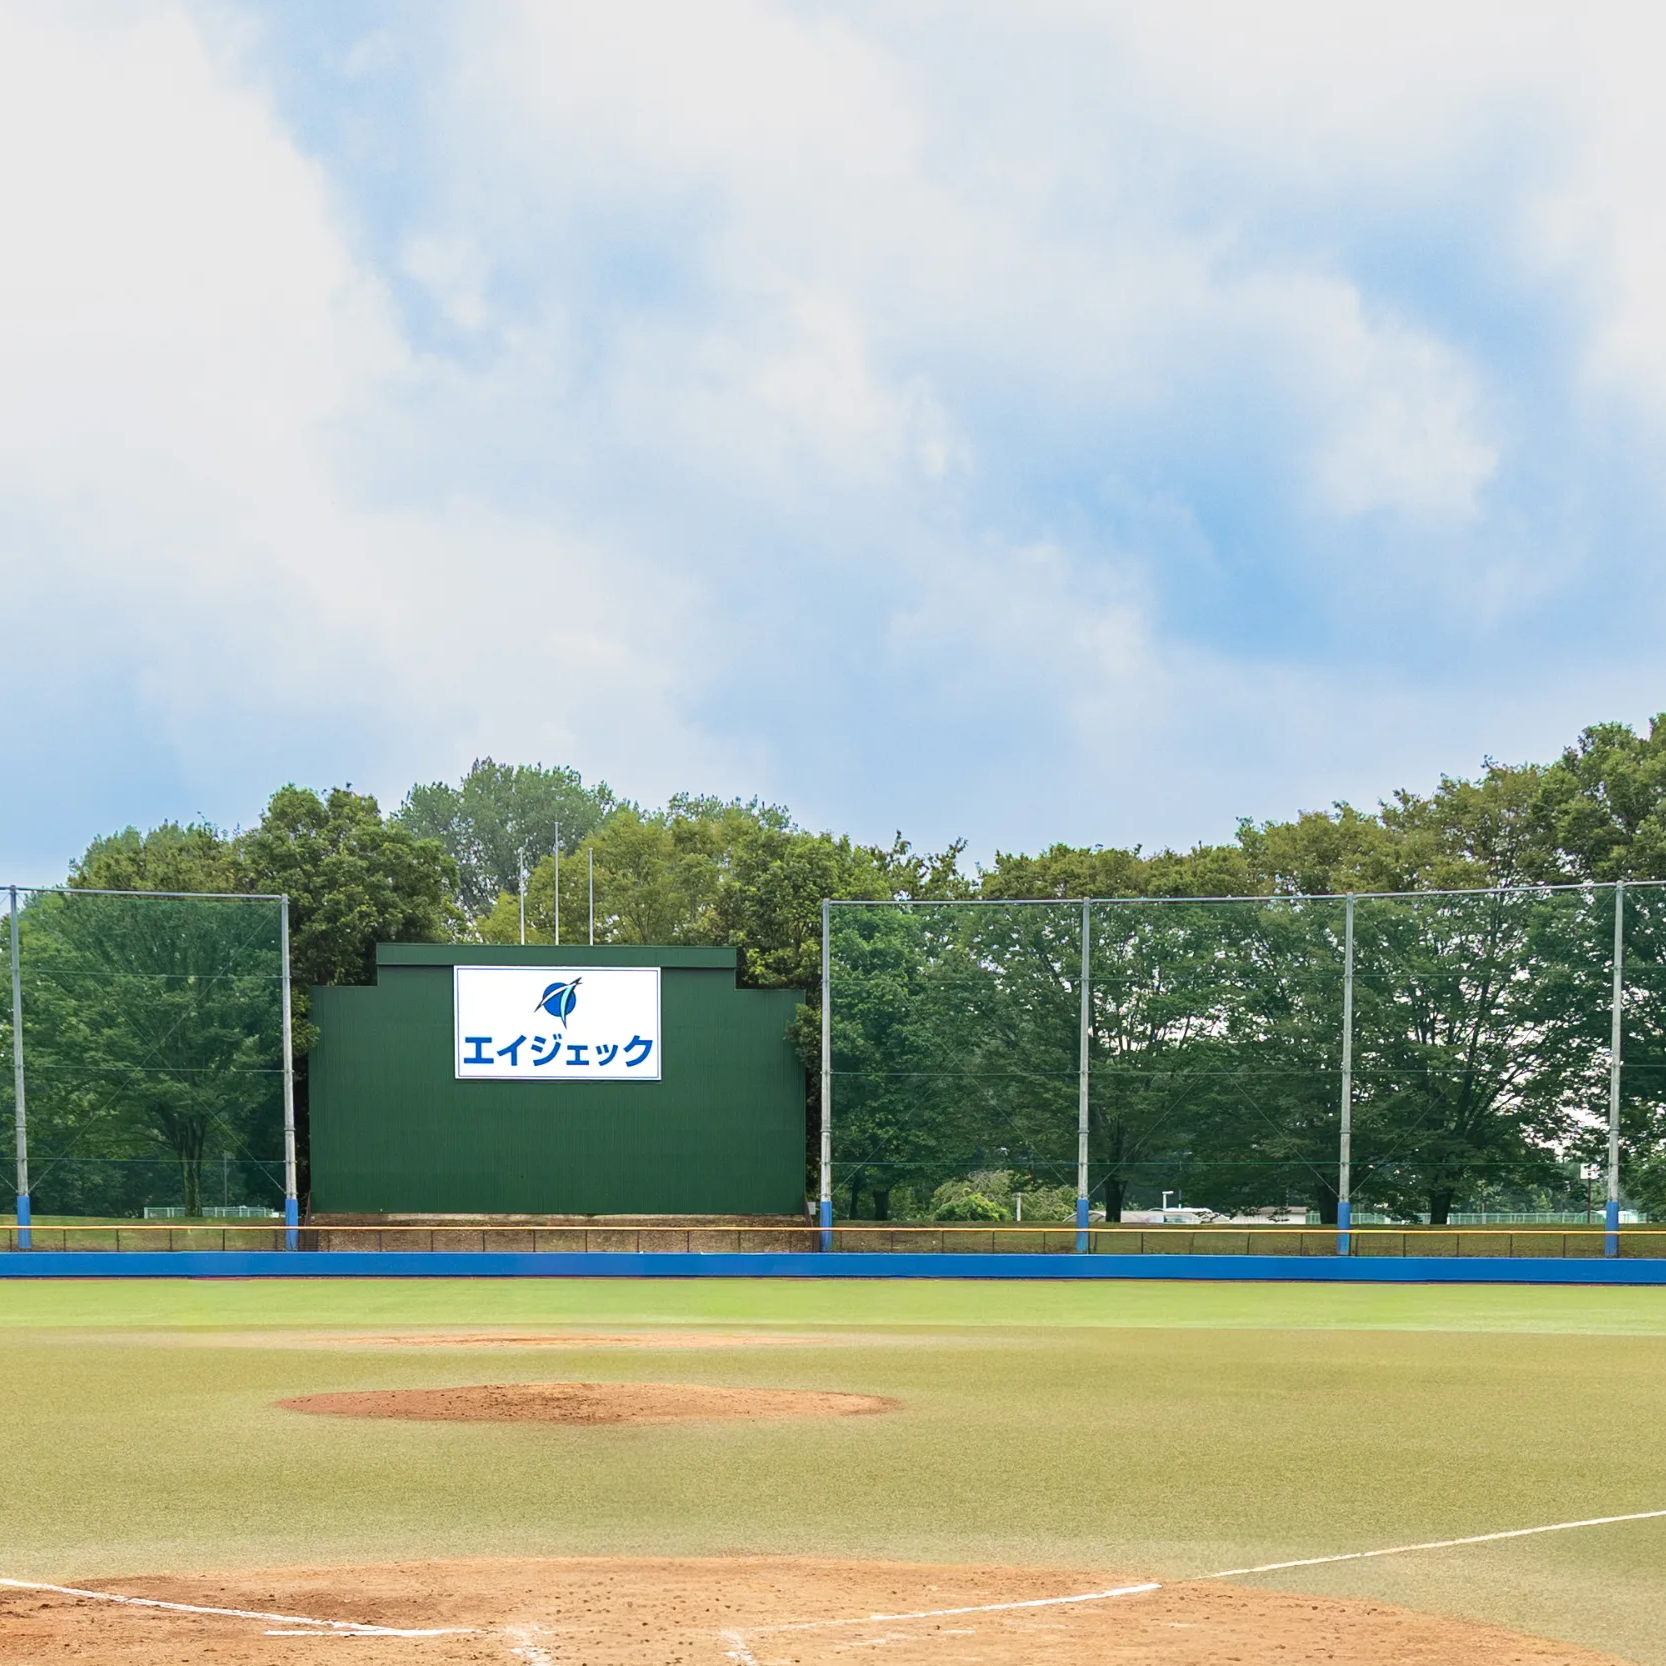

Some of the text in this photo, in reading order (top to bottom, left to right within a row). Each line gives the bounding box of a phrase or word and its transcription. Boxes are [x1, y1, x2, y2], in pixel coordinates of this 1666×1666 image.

[463, 1033, 654, 1067] エイジェック
